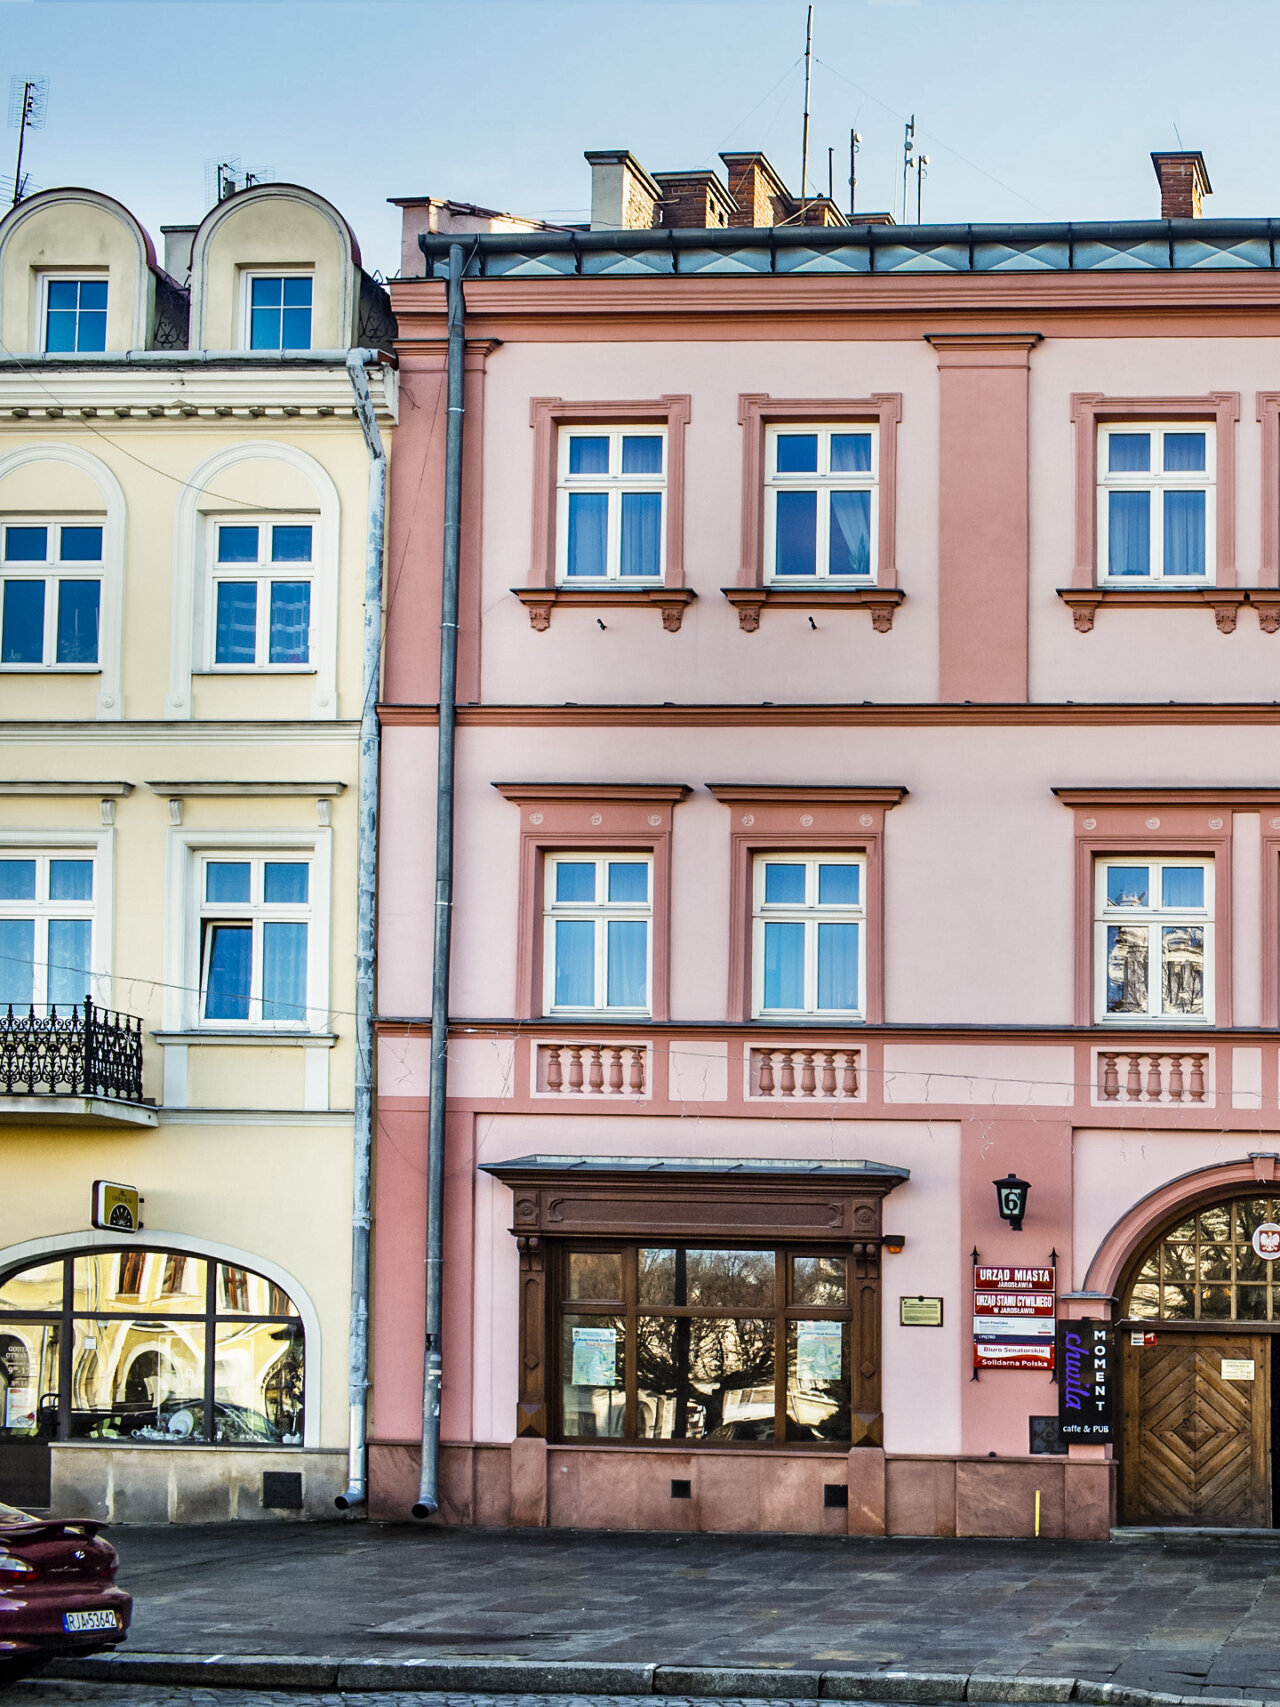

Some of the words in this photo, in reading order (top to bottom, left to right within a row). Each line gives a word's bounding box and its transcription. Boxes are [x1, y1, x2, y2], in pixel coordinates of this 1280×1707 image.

[1004, 1191, 1020, 1211] 6
[980, 1268, 1010, 1282] URZĄD
[1014, 1269, 1050, 1282] MIASTA
[997, 1281, 1033, 1289] JAROSŁAWIA
[976, 1294, 996, 1308] URZĄD
[996, 1295, 1017, 1307] STANU
[1017, 1296, 1053, 1308] CYWILNEGO
[1004, 1346, 1045, 1354] Senatorskie
[982, 1358, 1020, 1366] Solidarna
[1065, 1330, 1090, 1410] chwila
[1062, 1424, 1082, 1433] caffe
[1083, 1424, 1091, 1433] &
[1092, 1425, 1110, 1433] PUB
[67, 1613, 86, 1630] RJA
[88, 1611, 116, 1628] 53642
